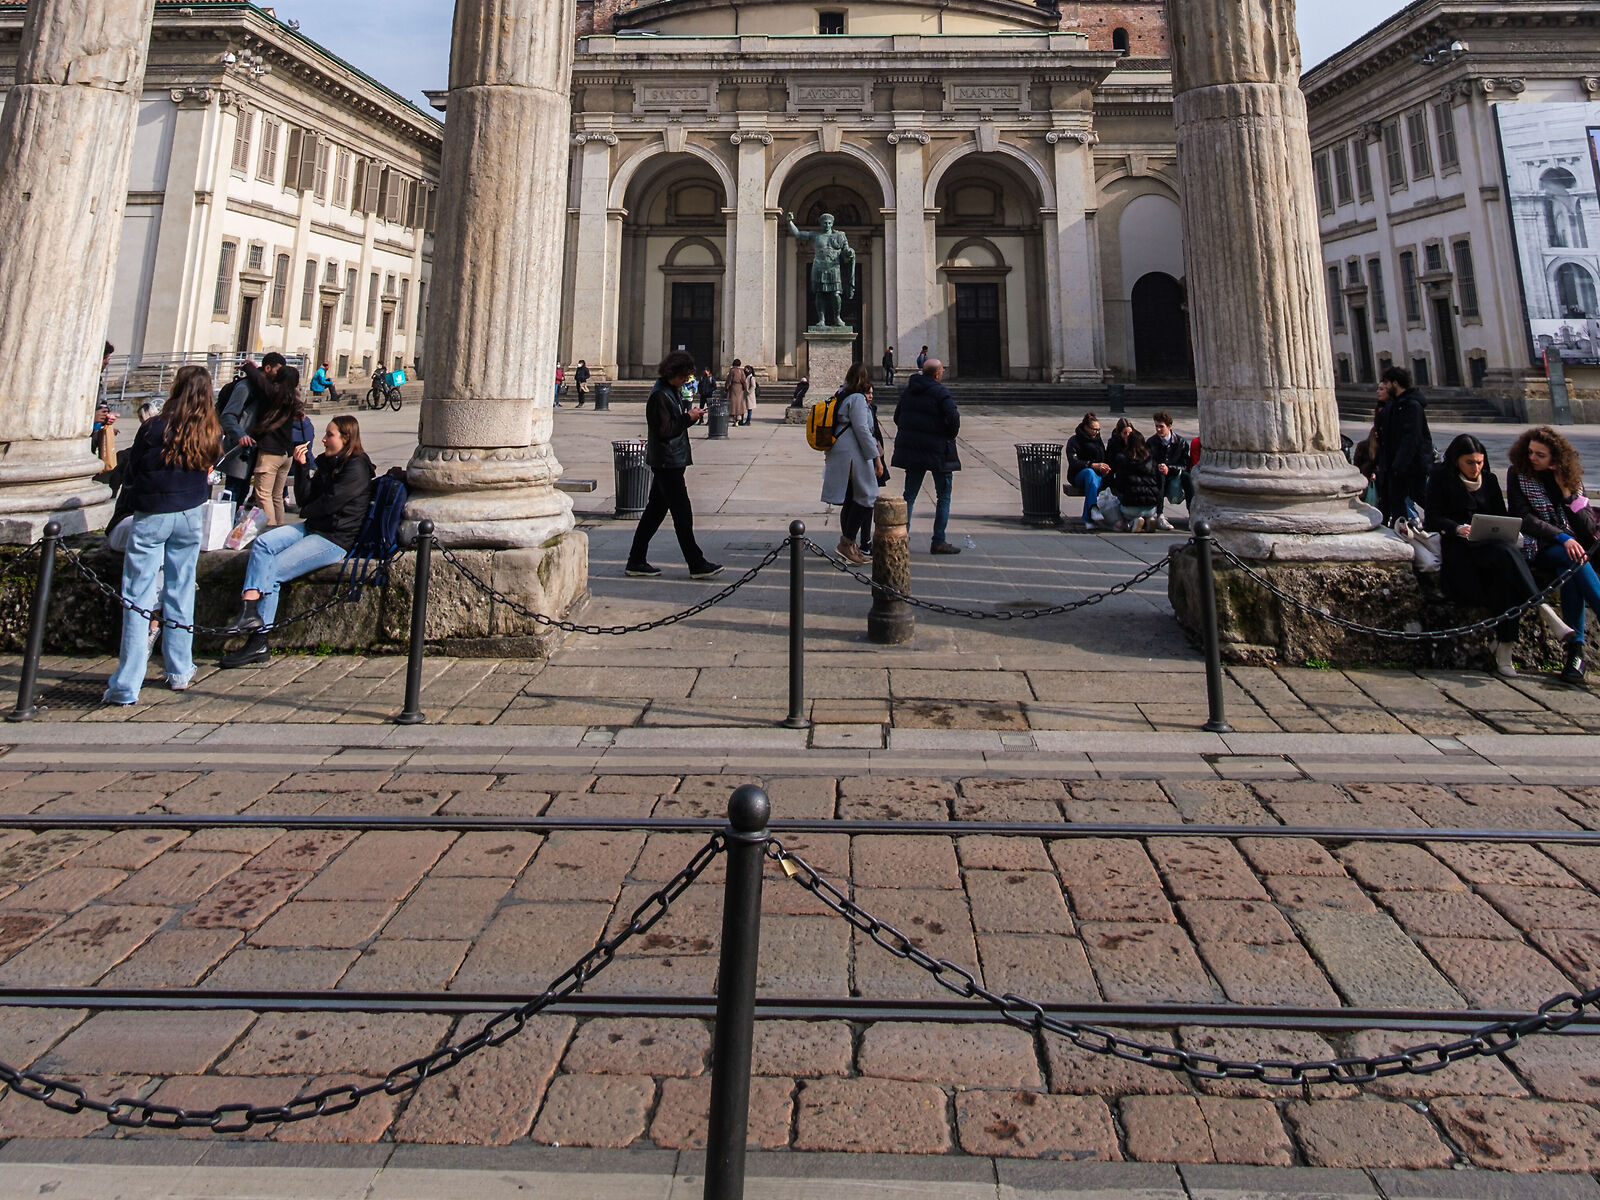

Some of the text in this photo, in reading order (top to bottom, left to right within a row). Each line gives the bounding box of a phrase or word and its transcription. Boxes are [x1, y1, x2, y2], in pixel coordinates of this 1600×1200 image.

[652, 87, 1014, 100] SANCTO LAVRENTIO MARTYRI
